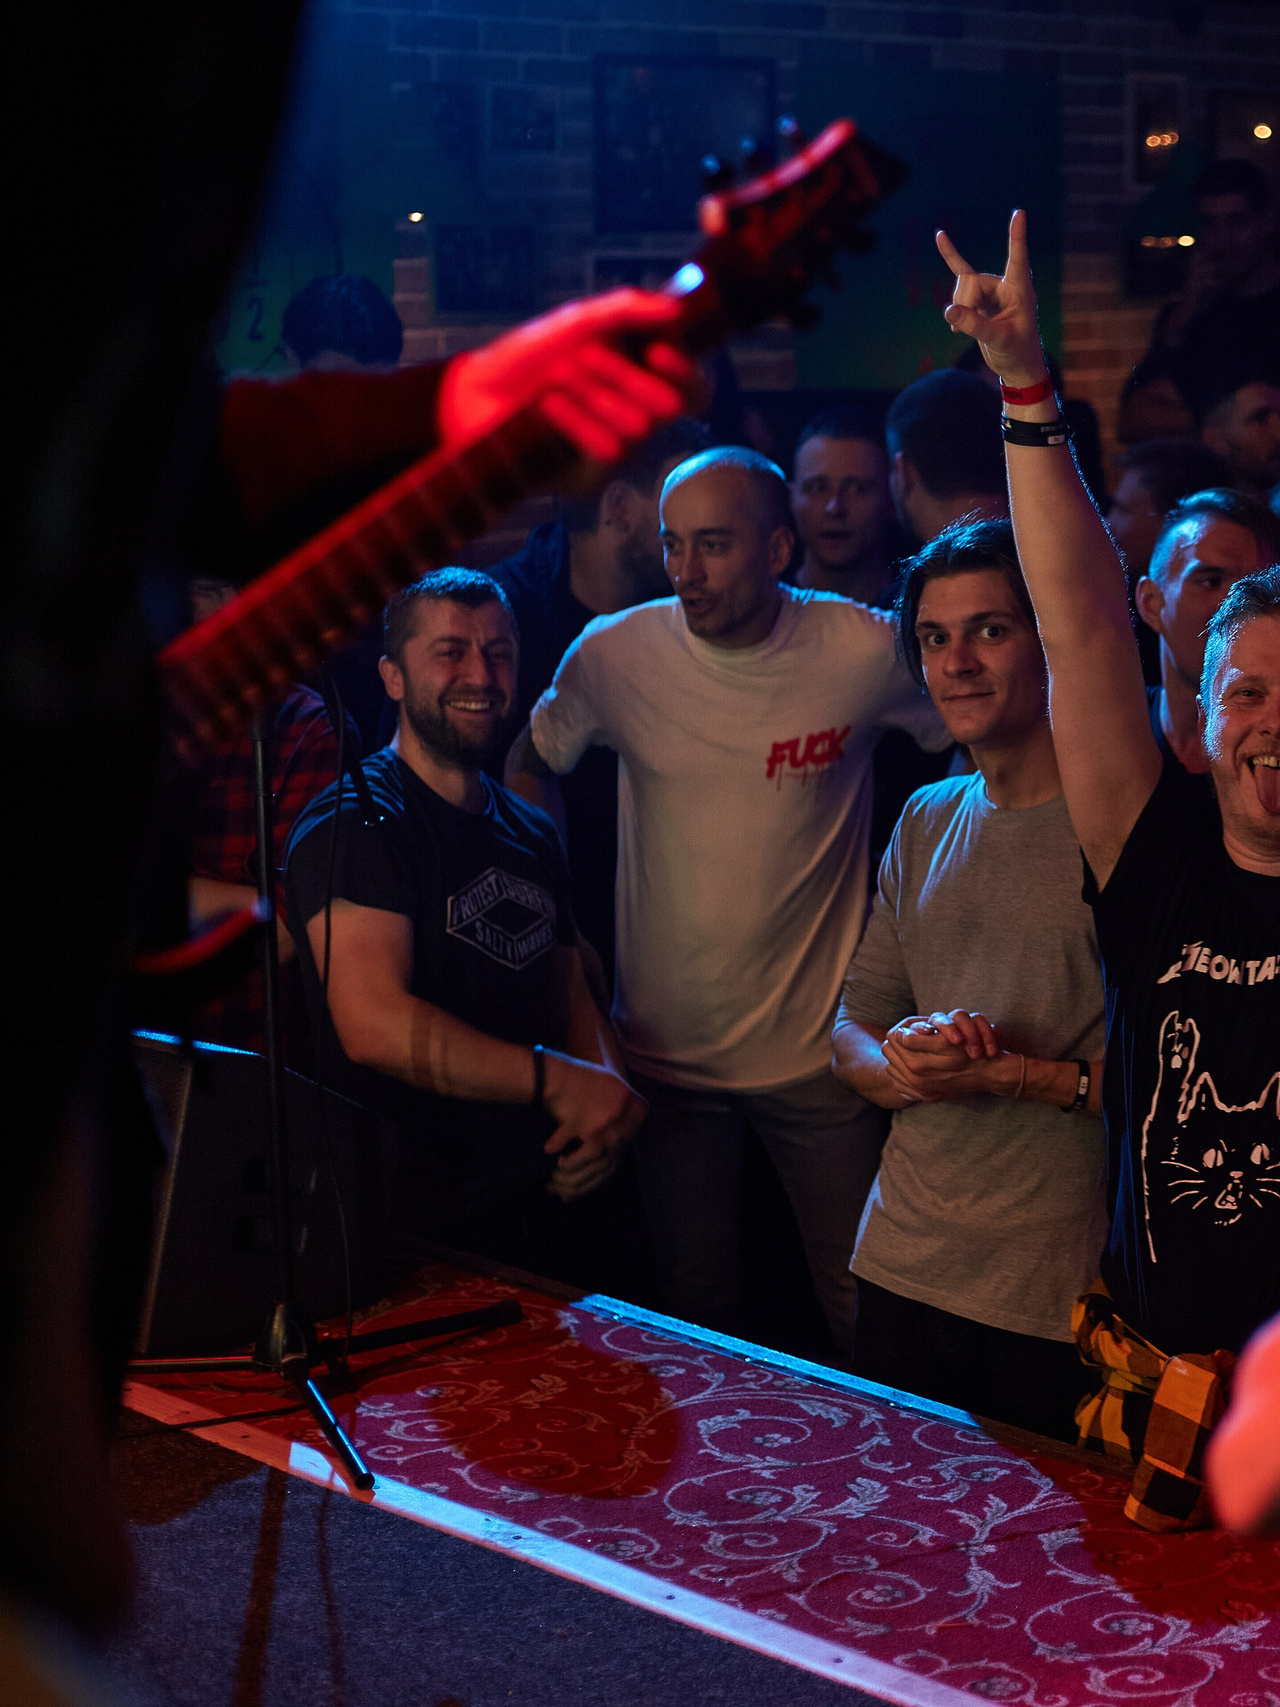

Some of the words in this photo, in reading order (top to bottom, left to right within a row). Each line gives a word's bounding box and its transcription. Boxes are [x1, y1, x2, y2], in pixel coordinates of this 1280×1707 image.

[766, 726, 851, 778] FUCK
[452, 872, 499, 926] PROTEST
[475, 920, 512, 960] SALTY
